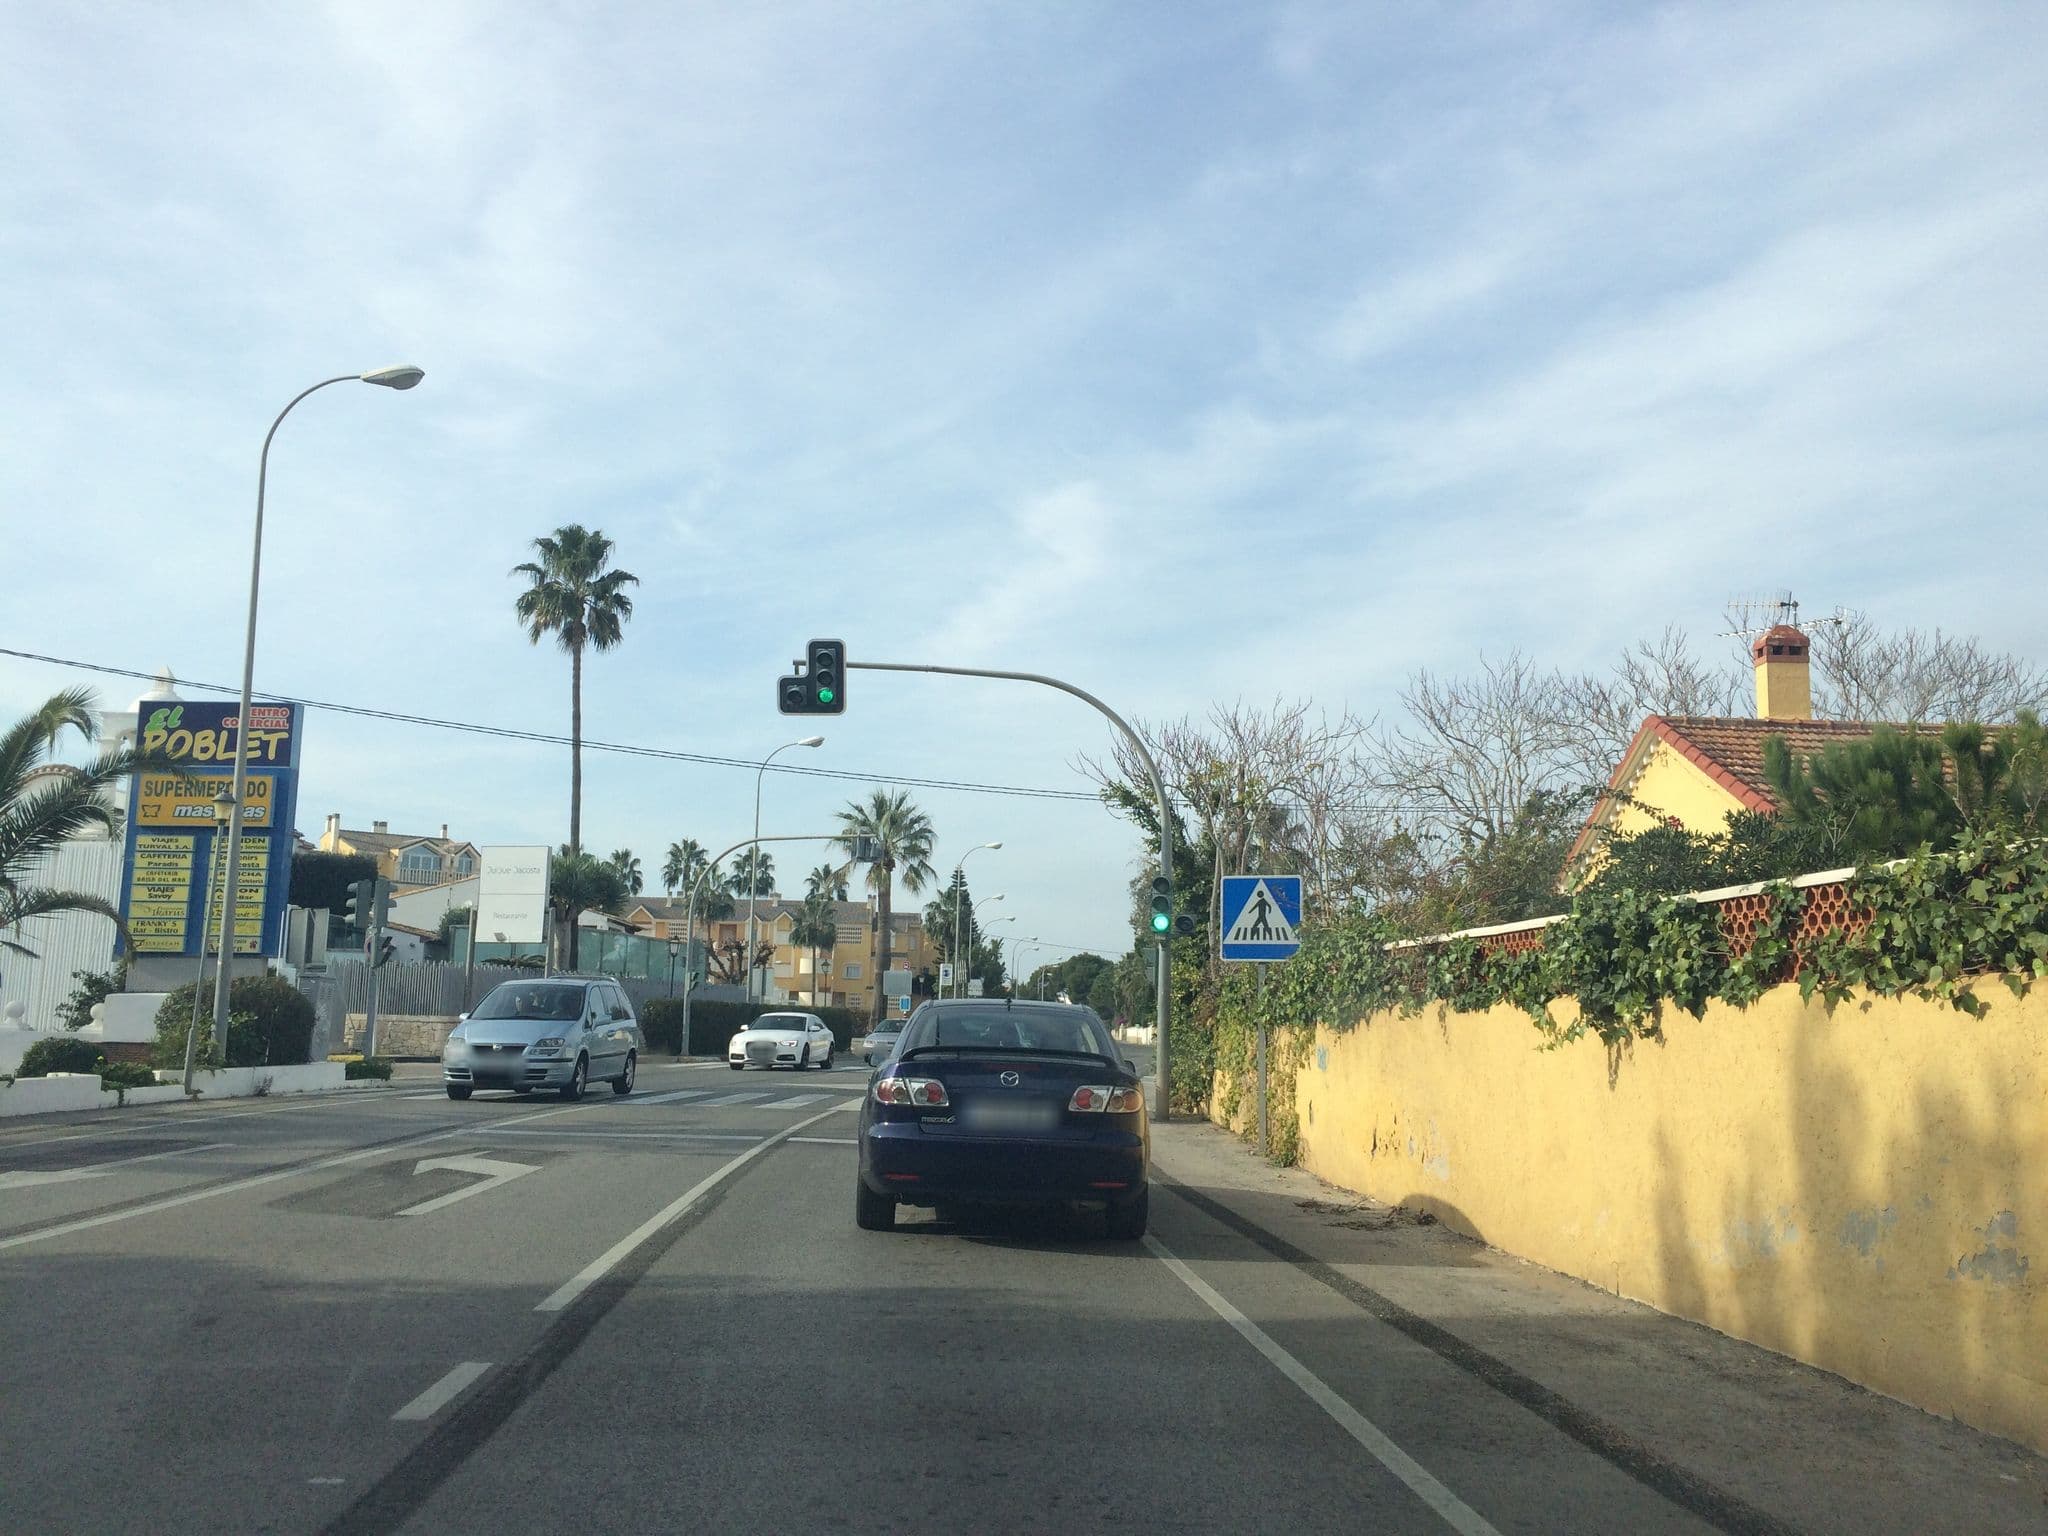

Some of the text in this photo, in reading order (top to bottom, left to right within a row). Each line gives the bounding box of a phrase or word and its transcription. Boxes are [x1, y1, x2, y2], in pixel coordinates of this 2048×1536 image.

[249, 707, 289, 718] ENTRO
[222, 717, 289, 729] COERCIAL
[144, 780, 267, 798] SUPERMERCDO
[173, 804, 266, 820] masas
